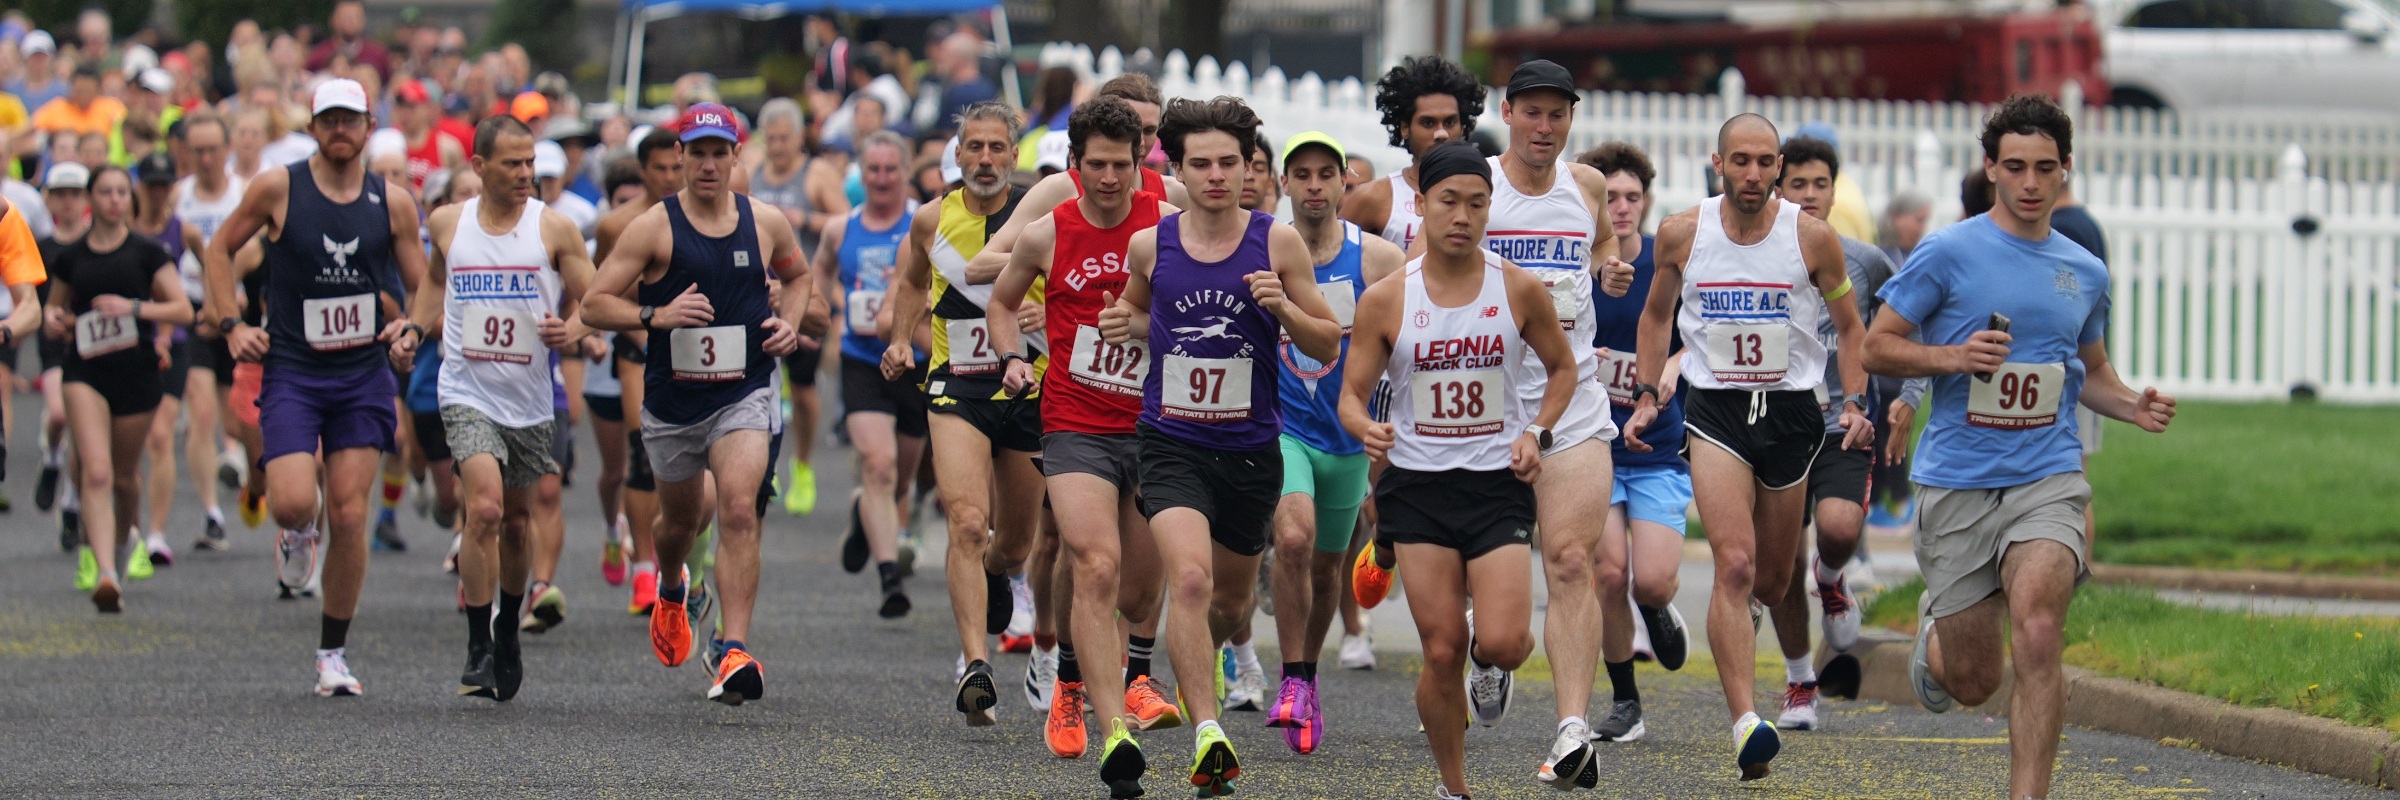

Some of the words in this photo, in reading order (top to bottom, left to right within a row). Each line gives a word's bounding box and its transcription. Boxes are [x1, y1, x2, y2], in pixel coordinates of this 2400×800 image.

[695, 113, 723, 127] USA
[1490, 239, 1548, 260] SHORE
[1552, 239, 1583, 262] A.C.
[315, 275, 367, 286] MARATHON
[322, 266, 359, 277] MESA
[453, 273, 503, 293] SHORE
[509, 273, 538, 293] A.C.
[1175, 289, 1246, 314] CLIFTON
[1700, 291, 1754, 311] SHORE
[1759, 291, 1790, 311] A.C.
[88, 316, 123, 343] 123
[321, 303, 362, 336] 104
[483, 315, 515, 348] 93
[700, 335, 716, 367] 3
[971, 326, 993, 357] 2
[1414, 334, 1505, 363] LEONIA
[1733, 333, 1763, 367] 13
[1088, 339, 1143, 381] 102
[1413, 358, 1461, 373] TRACK
[1465, 356, 1505, 369] CLUB
[1071, 374, 1110, 390] TRISTATE
[1189, 368, 1227, 404] 97
[1610, 360, 1637, 391] 15
[1756, 372, 1785, 380] TIMING
[1431, 380, 1485, 419] 138
[1999, 372, 2040, 410] 96
[1165, 407, 1206, 419] TRISTATE
[1215, 410, 1248, 418] TIMING
[1970, 414, 2016, 426] TRISTATE
[2025, 416, 2054, 426] TIMING
[1418, 425, 1459, 435] TRISTATE
[1468, 423, 1501, 432] TIMING
